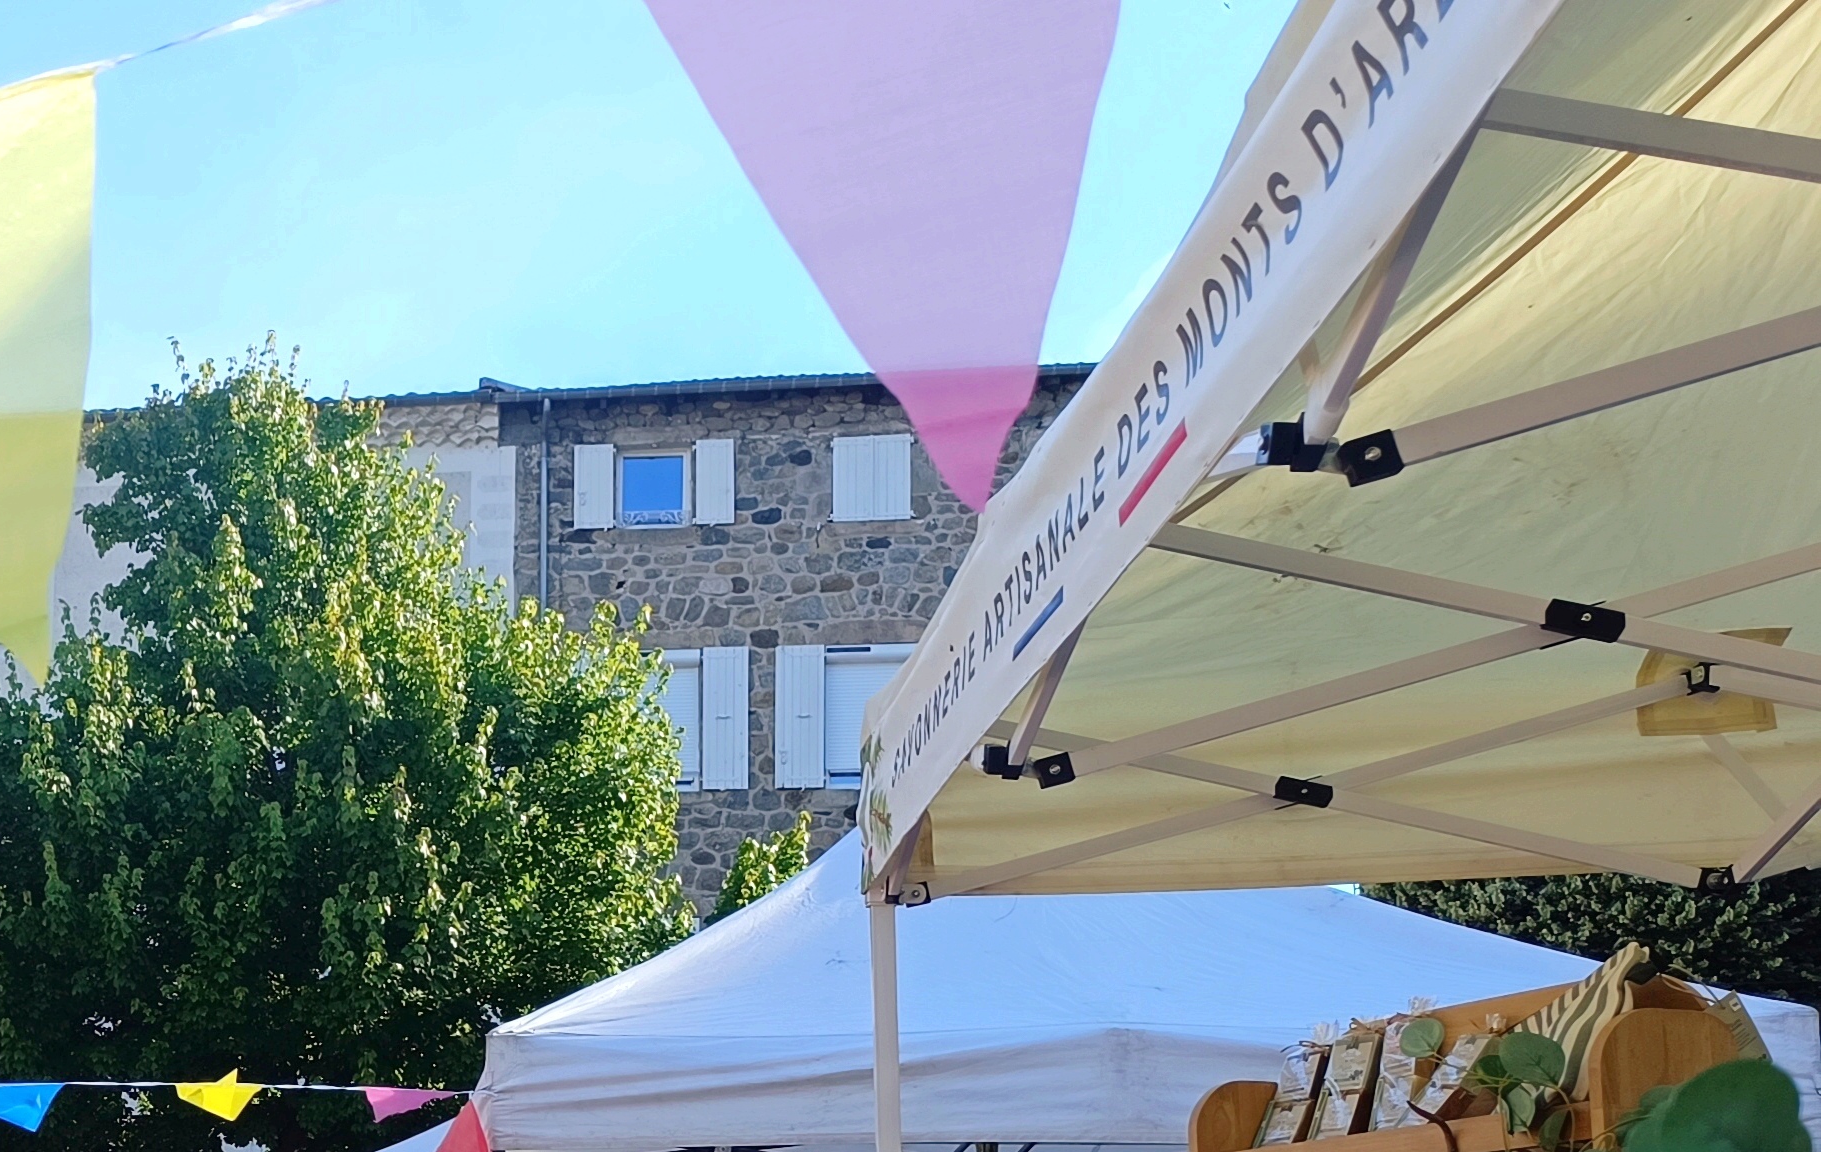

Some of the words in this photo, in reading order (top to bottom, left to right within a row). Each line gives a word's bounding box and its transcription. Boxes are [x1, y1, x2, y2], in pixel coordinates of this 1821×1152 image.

[892, 630, 976, 788] SAVONNERIE
[983, 446, 1105, 662] ARTISANALE
[1116, 360, 1170, 480] DES
[1176, 171, 1302, 389] MONTS
[1301, 0, 1454, 192] D'AR
